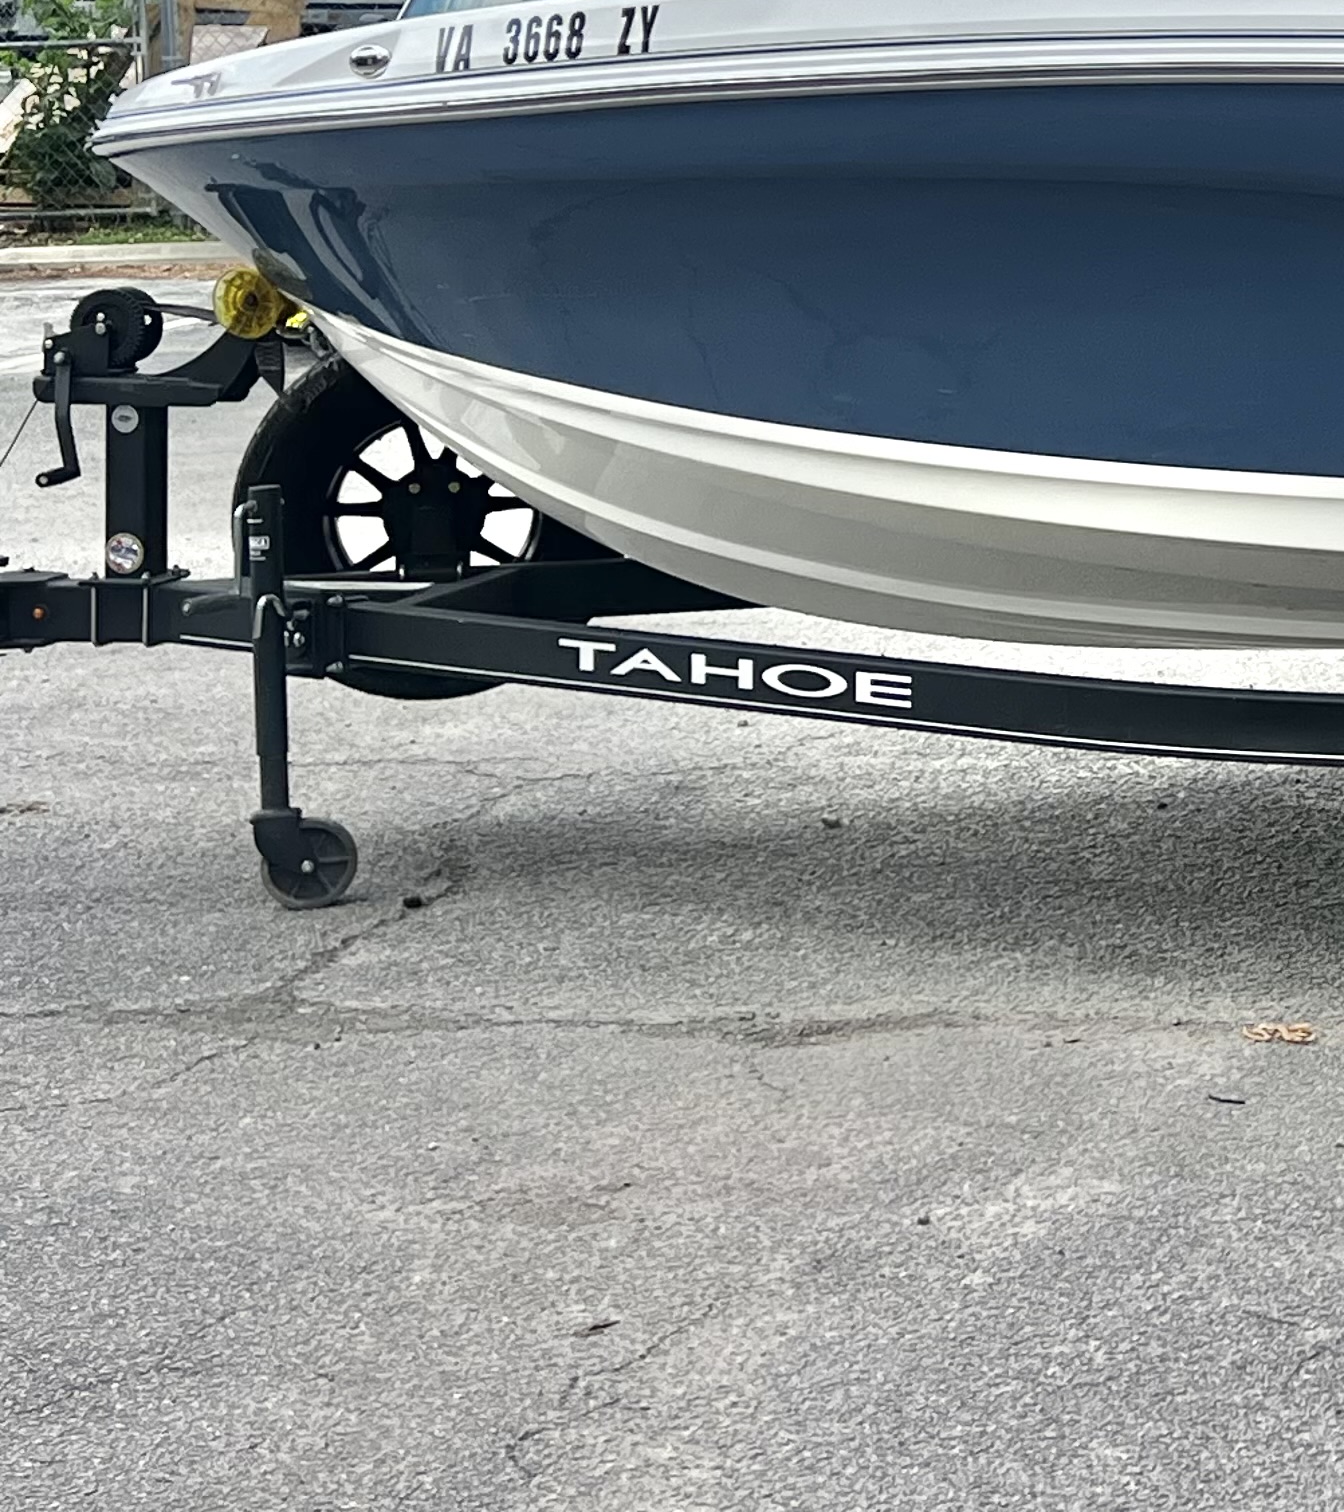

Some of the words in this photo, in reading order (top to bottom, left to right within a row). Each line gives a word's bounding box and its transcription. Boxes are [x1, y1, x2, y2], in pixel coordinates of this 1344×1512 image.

[436, 24, 474, 73] VA
[503, 11, 587, 65] 3668
[617, 4, 661, 55] ZY
[558, 638, 912, 708] TAHOE
